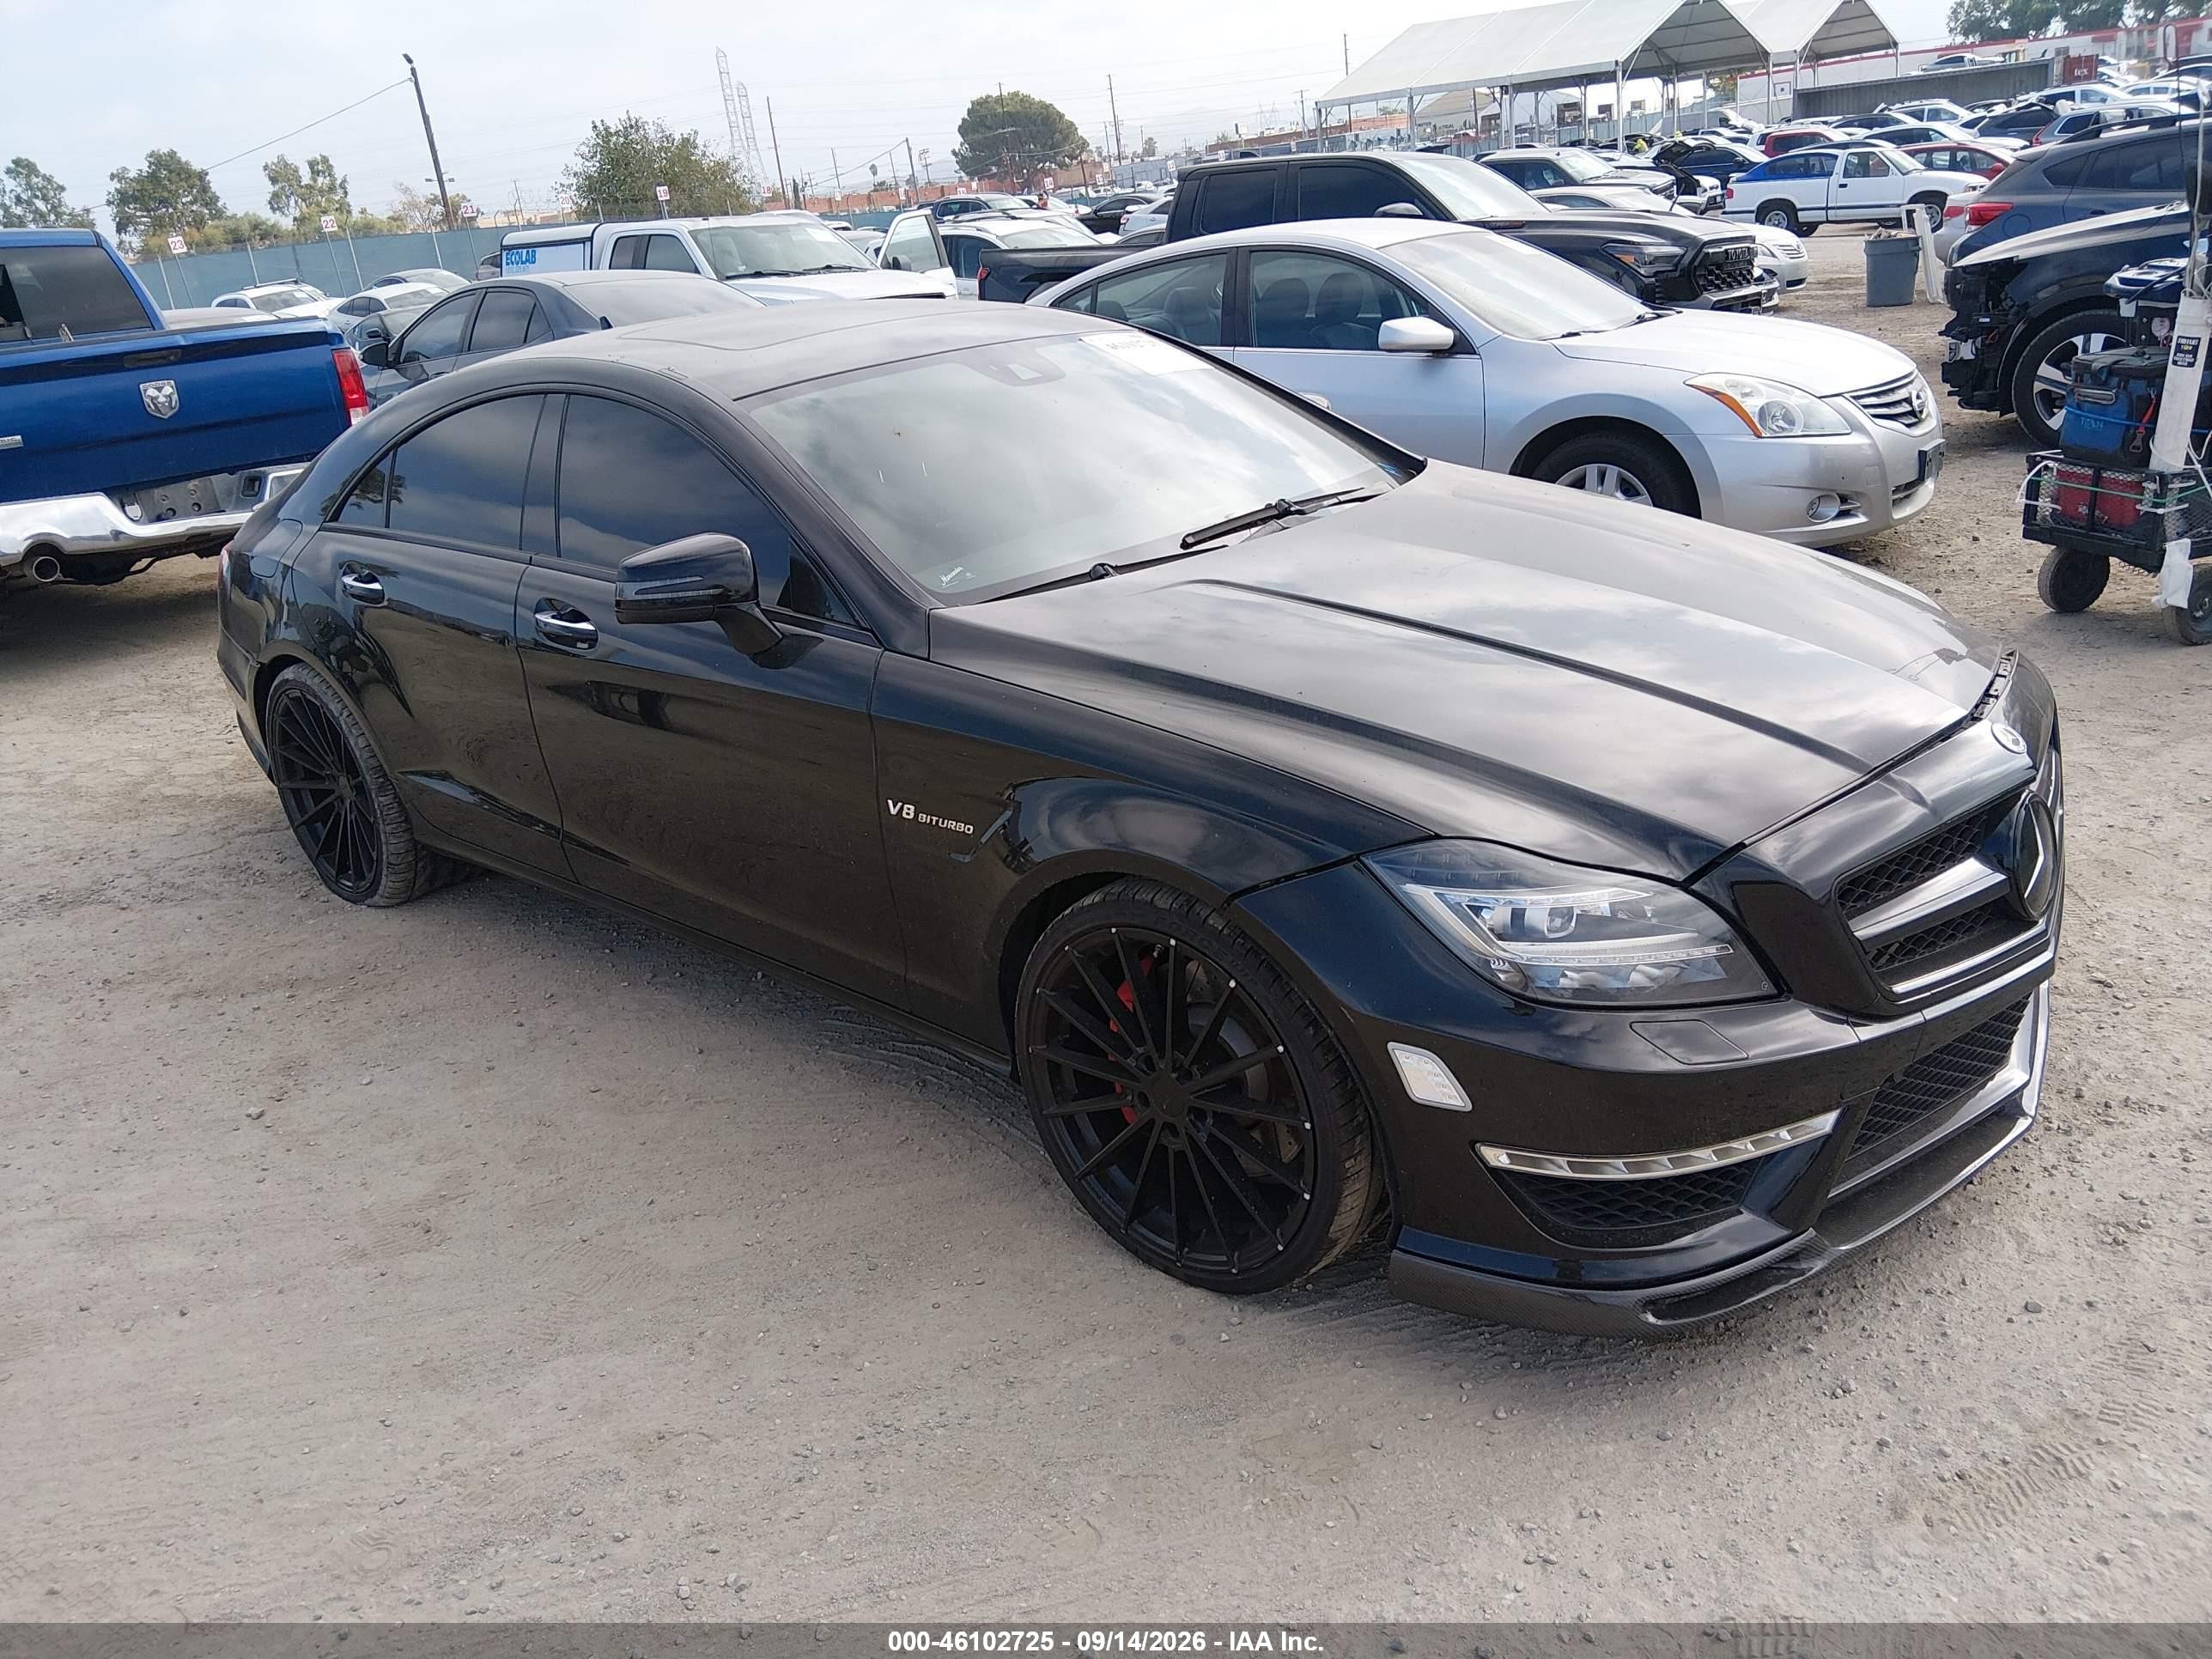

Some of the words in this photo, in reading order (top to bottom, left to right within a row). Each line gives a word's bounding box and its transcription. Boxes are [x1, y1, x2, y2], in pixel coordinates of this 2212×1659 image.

[659, 189, 668, 198] 19
[763, 185, 771, 194] 18
[560, 196, 570, 205] 20
[463, 205, 476, 215] 21
[323, 218, 336, 229] 22
[171, 240, 185, 251] 23
[506, 250, 537, 266] ECOLAB
[1728, 247, 1750, 261] TOYOTA
[887, 799, 915, 819] V8
[918, 812, 974, 835] BITURBO
